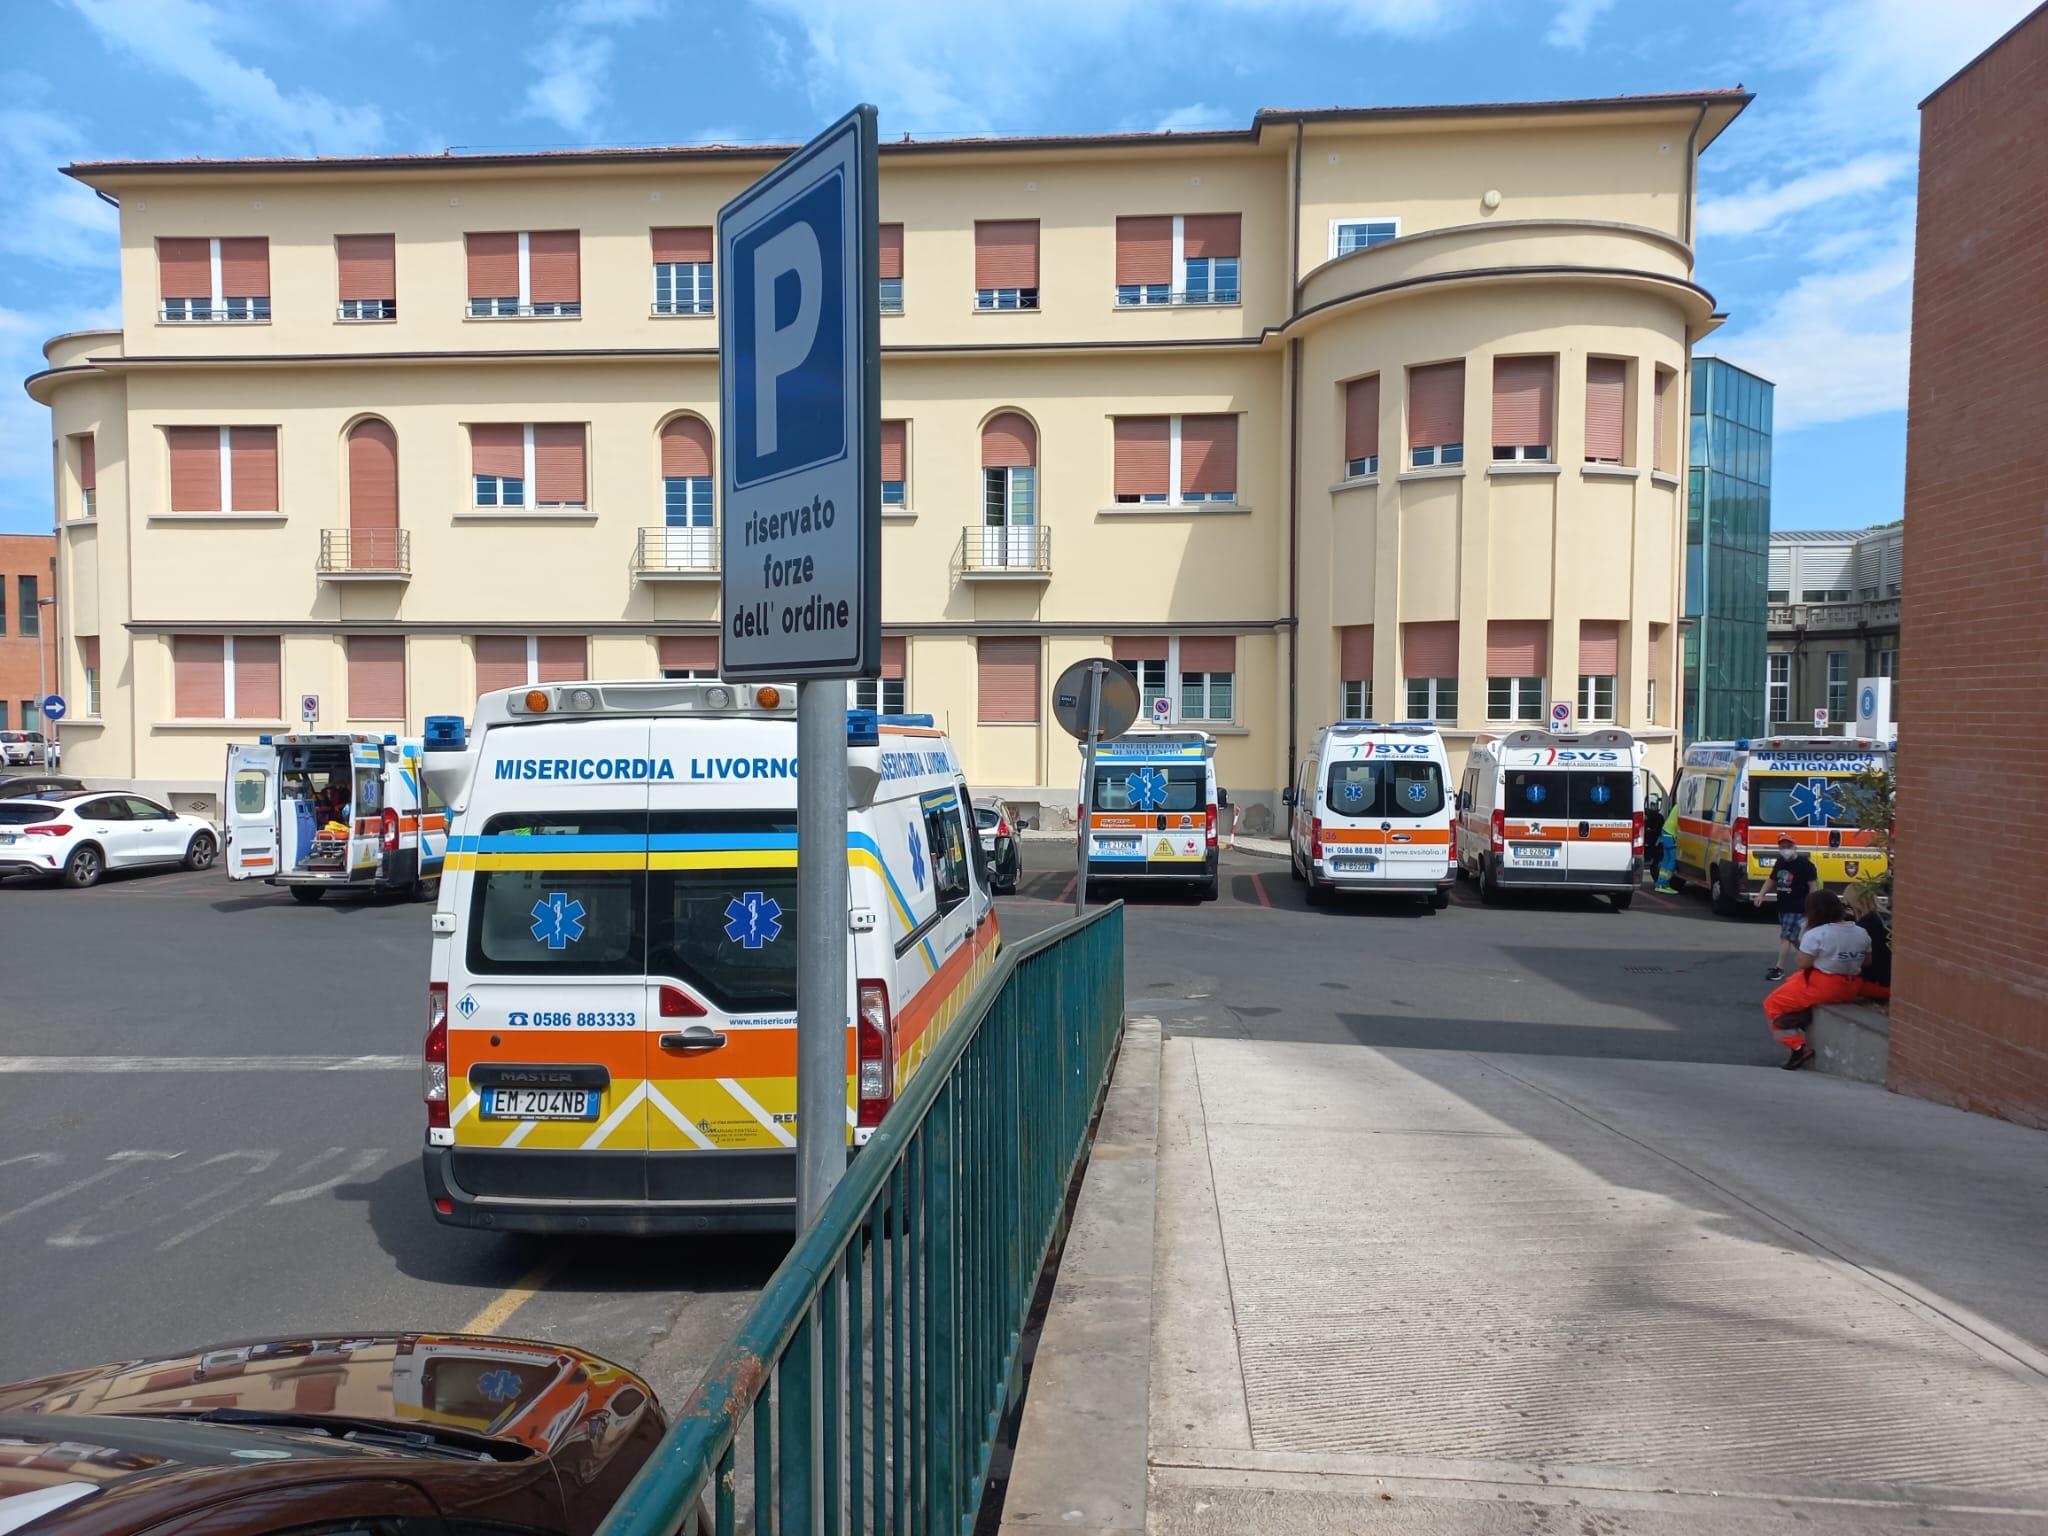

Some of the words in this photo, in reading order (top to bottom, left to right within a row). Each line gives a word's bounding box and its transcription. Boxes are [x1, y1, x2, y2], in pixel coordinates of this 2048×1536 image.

[754, 220, 823, 459] P
[745, 493, 835, 547] riservato
[763, 552, 814, 589] forze
[781, 593, 849, 635] ordine
[1375, 744, 1430, 754] SVS
[1558, 751, 1618, 761] SVS
[1757, 752, 1875, 762] MISERICORDIA
[494, 758, 675, 780] MISERICORDIA
[1769, 762, 1864, 771] ANTIGNANO
[1325, 831, 1337, 840] 36
[533, 1012, 572, 1027] 0586
[576, 1012, 636, 1027] 883333
[500, 1071, 572, 1083] MASTER
[495, 1090, 518, 1113] EM
[525, 1091, 586, 1114] 204NB
